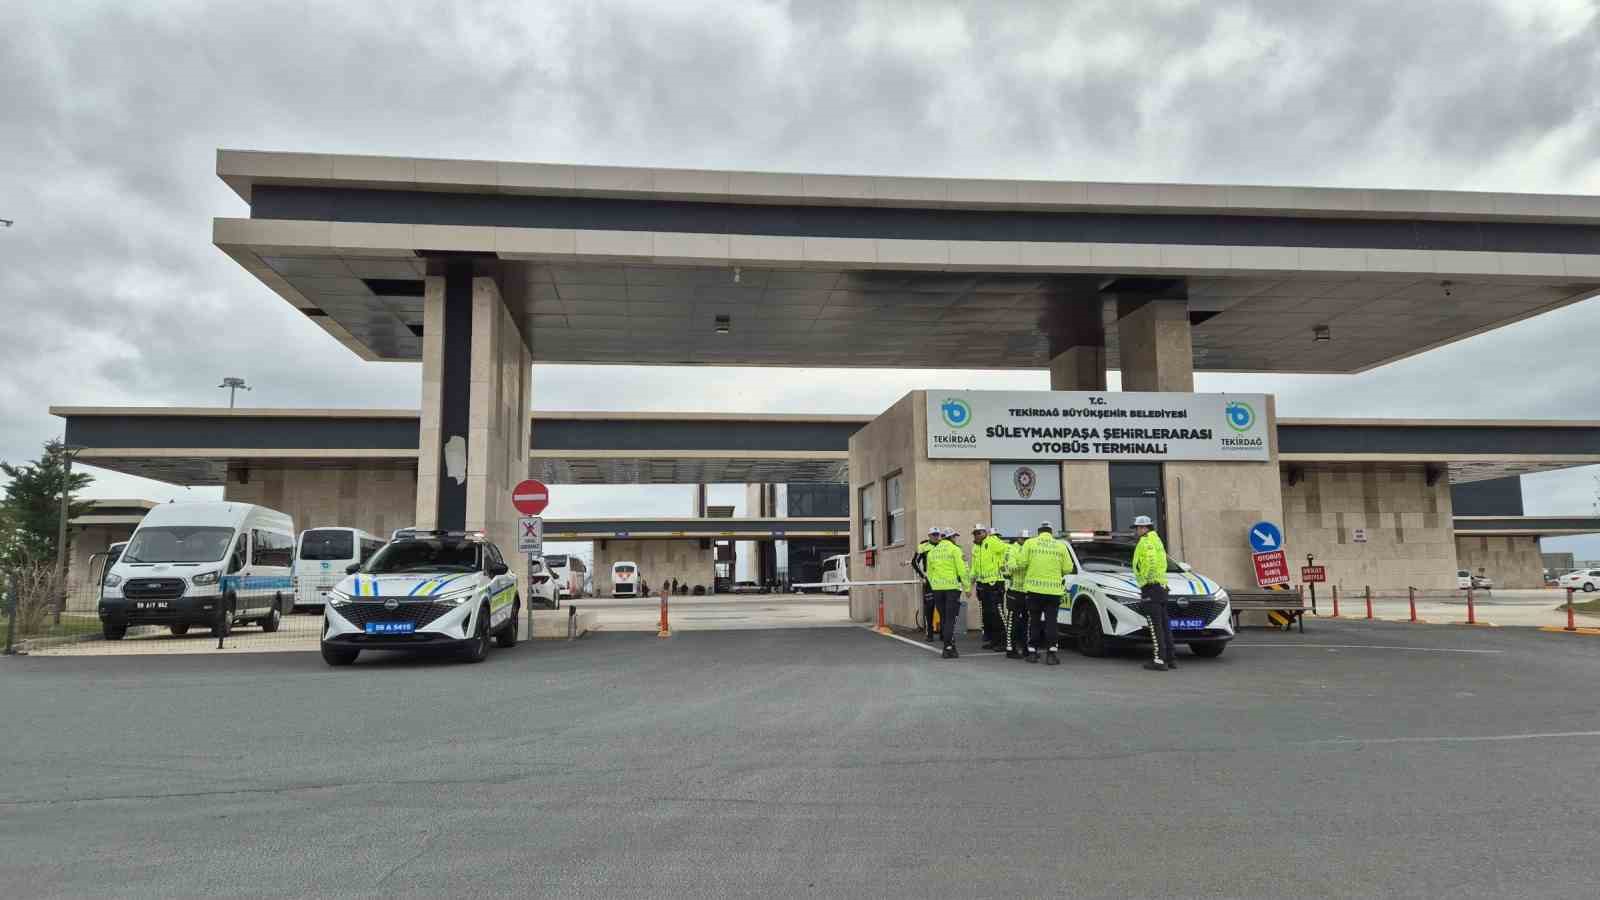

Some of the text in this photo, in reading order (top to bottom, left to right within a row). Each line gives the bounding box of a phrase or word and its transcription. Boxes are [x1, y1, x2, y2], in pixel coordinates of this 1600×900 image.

[1088, 397, 1108, 405] T.C.
[1008, 407, 1187, 419] TEKİRDAĞ BÜYÜKŞEHİR BELEDİYESİ
[985, 425, 1212, 440] SÜLEYMANPAŞA ŞEHİRLERARASI
[934, 434, 977, 444] TEKİRDAĞ
[1220, 437, 1263, 447] TEKİRDAĞ
[1032, 440, 1168, 455] OTOBÜS TERMİNALİ
